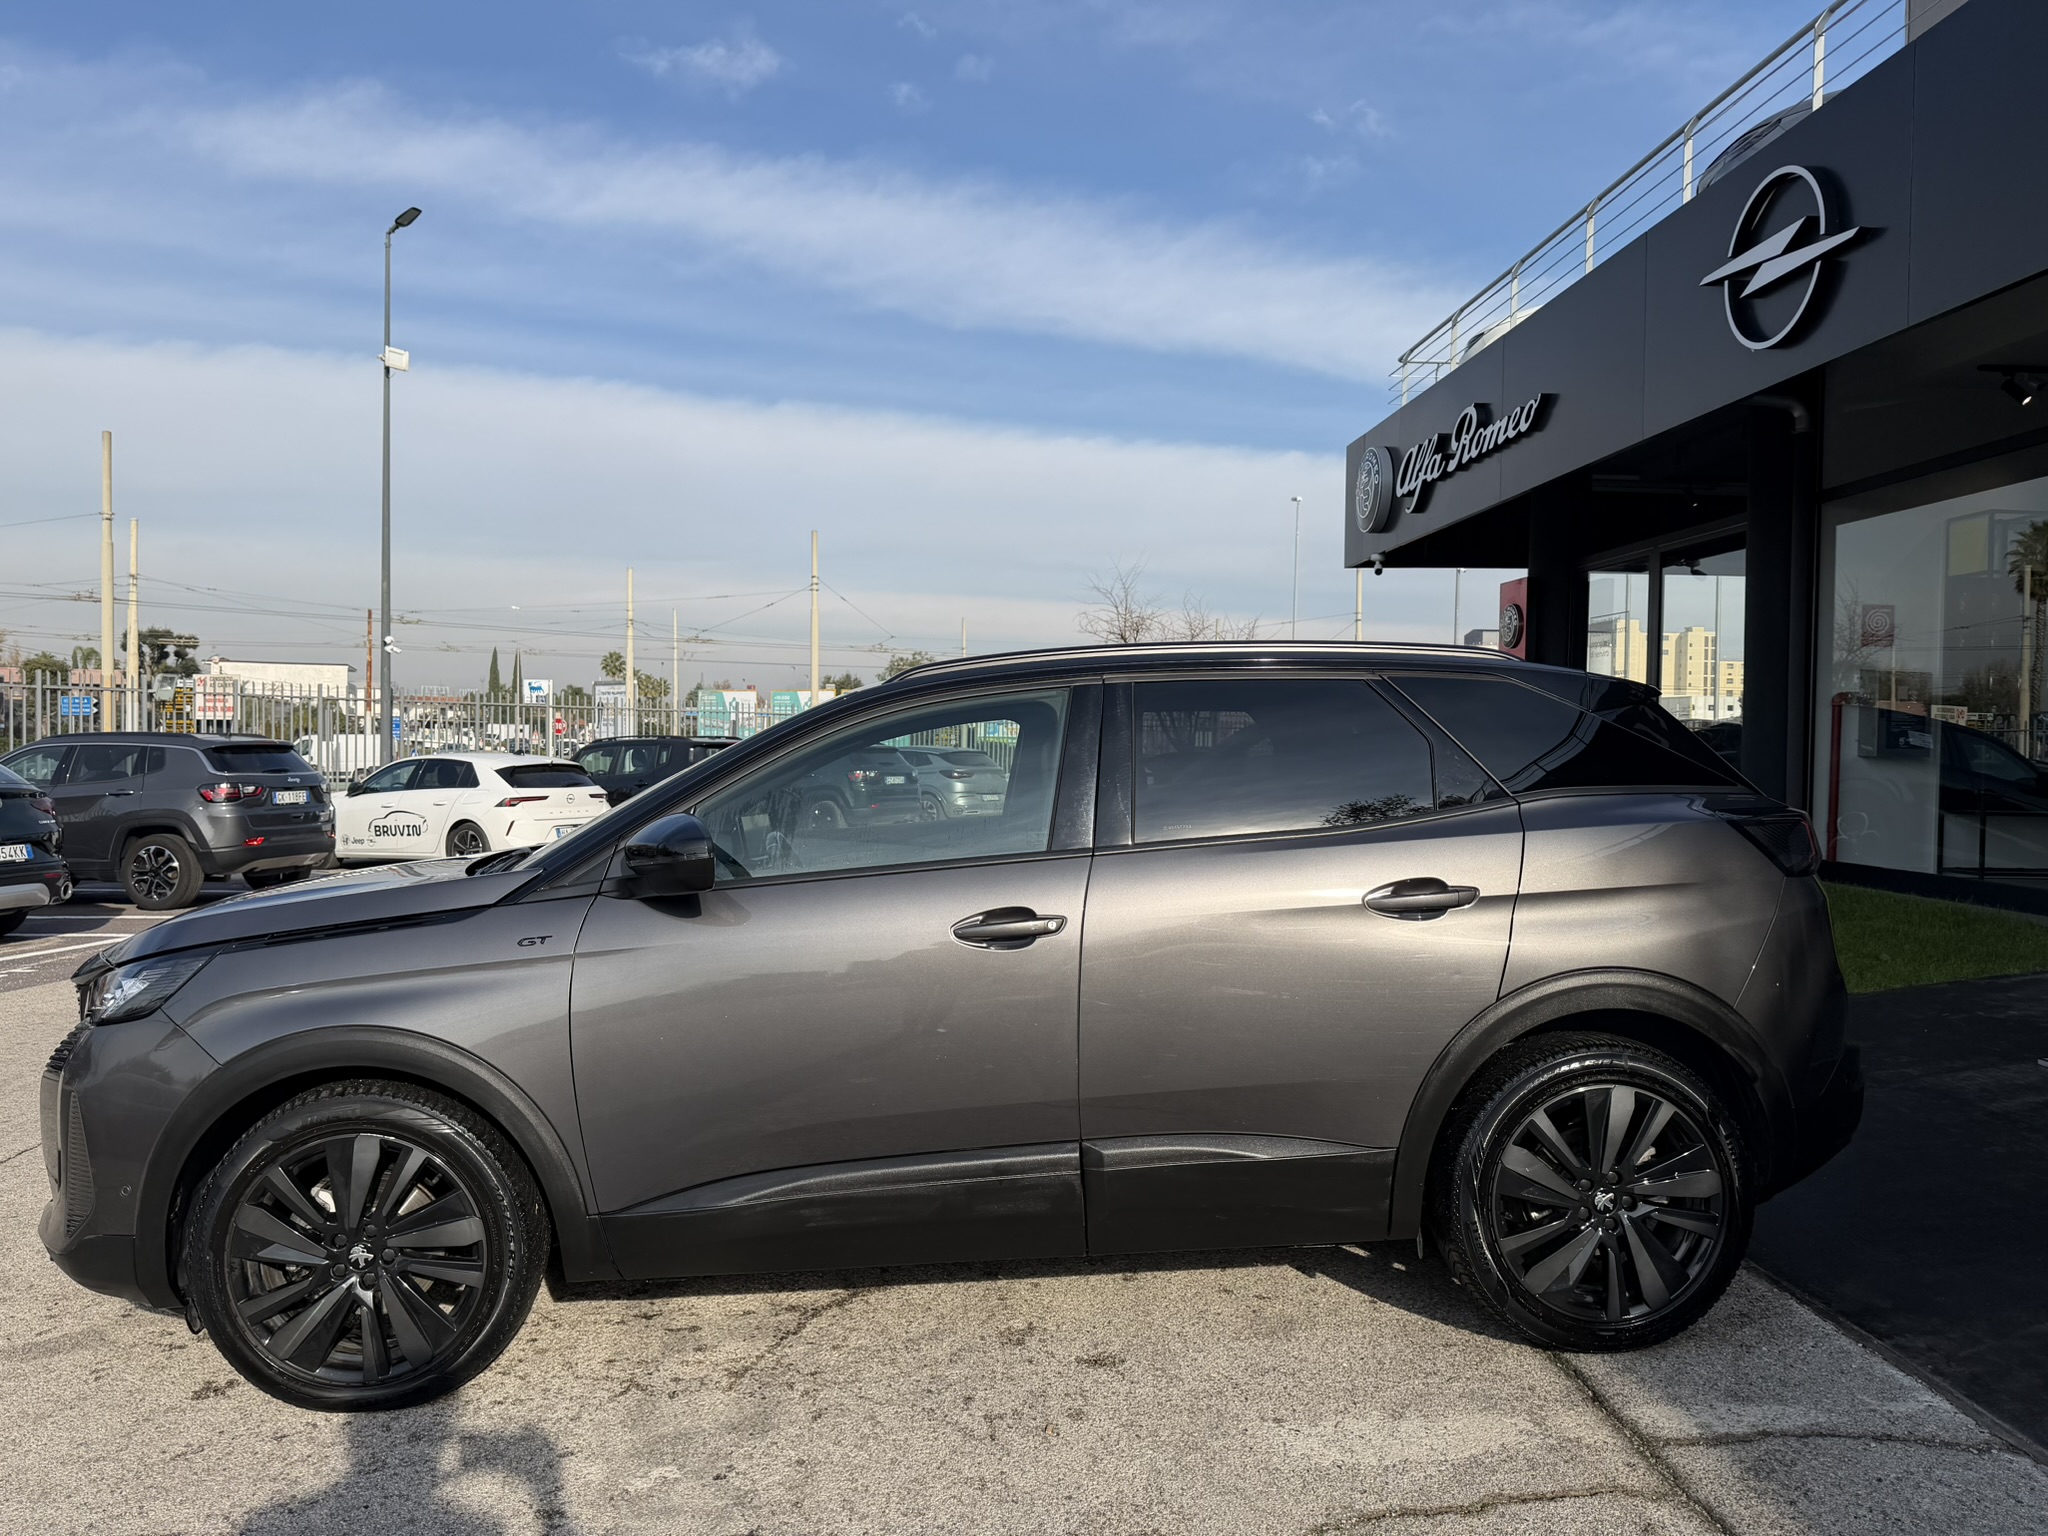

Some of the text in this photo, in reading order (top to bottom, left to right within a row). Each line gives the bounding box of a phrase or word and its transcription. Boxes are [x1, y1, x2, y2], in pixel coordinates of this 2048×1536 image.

[1396, 432, 1446, 514] Alfa
[1447, 393, 1542, 472] Romeo
[374, 824, 422, 837] BRUVIN
[351, 837, 365, 846] Jeep
[0, 846, 27, 860] 54KK
[517, 935, 553, 947] GT
